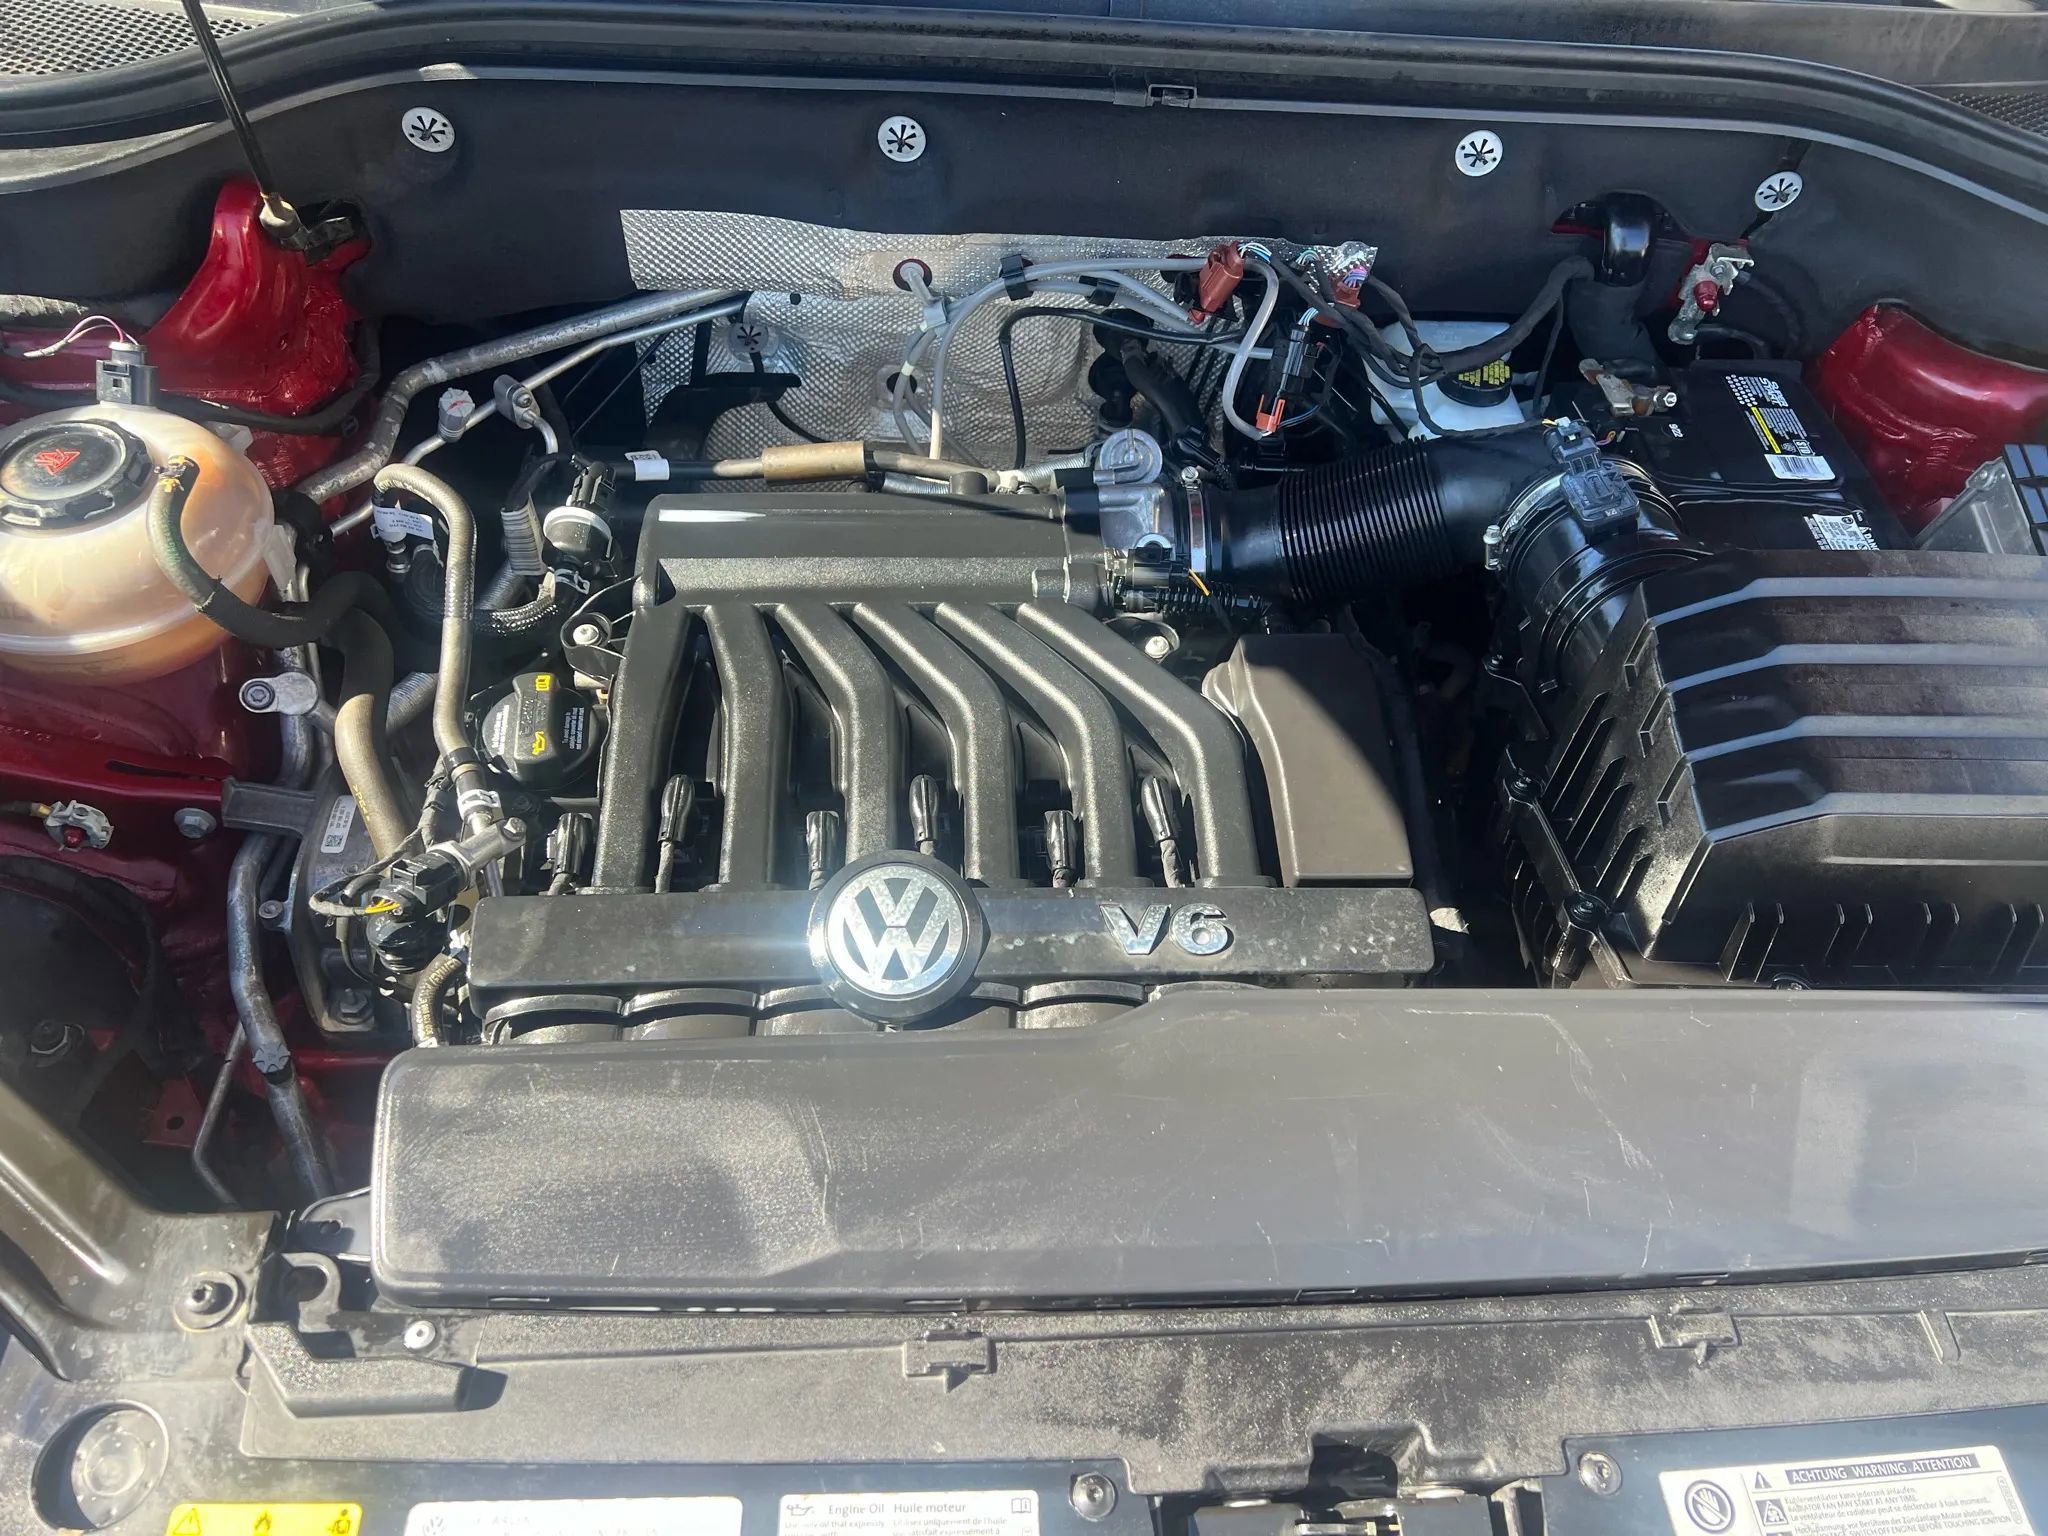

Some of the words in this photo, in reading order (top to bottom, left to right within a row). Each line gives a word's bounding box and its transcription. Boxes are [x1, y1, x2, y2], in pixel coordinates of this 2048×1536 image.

[827, 863, 969, 998] VW
[1099, 904, 1234, 956] V6
[1792, 1467, 1847, 1483] ACHTUNG
[1851, 1462, 1907, 1478] WARNING
[1912, 1455, 1972, 1473] ATTENTION
[894, 1503, 922, 1513] Huile
[926, 1503, 966, 1513] moteur
[1822, 1501, 1837, 1510] FAN
[1837, 1500, 1853, 1508] MAY
[1854, 1498, 1874, 1507] START
[1884, 1496, 1898, 1504] ANY
[828, 1504, 866, 1518] Engine
[869, 1503, 884, 1513] Oil
[831, 1520, 847, 1528] that
[973, 1517, 982, 1525] de
